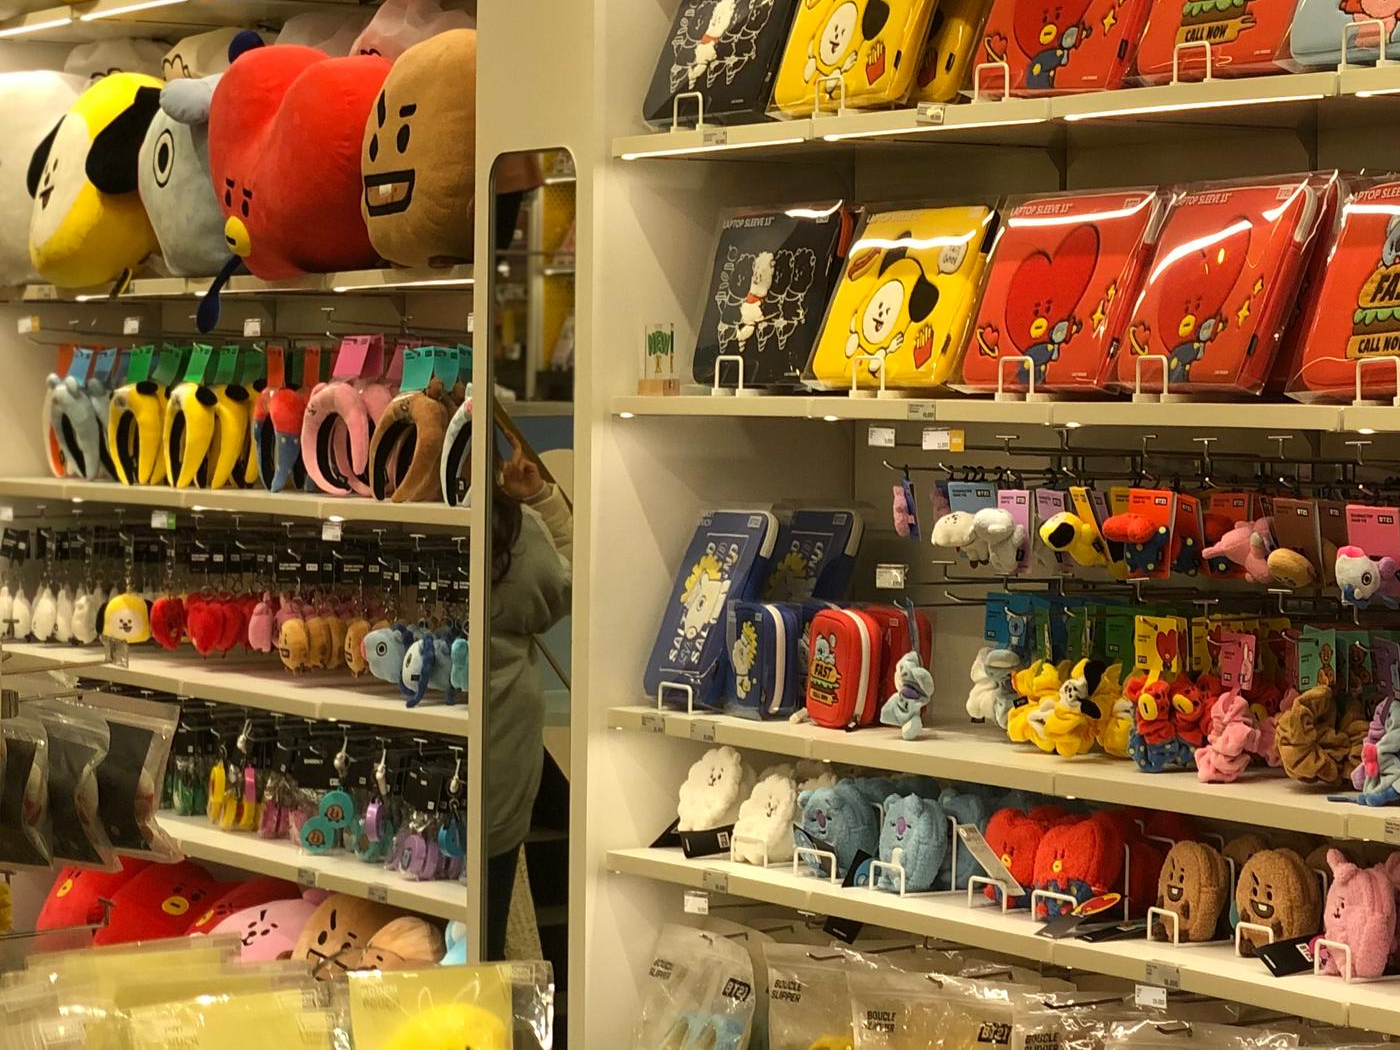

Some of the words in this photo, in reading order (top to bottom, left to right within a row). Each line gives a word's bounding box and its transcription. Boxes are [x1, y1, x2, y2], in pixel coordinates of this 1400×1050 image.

[1185, 27, 1206, 43] CALL
[1206, 24, 1229, 39] NOW
[1037, 204, 1060, 215] SLEEVE
[648, 330, 671, 357] NEW
[1358, 338, 1380, 352] CALL
[815, 663, 833, 679] FAST
[774, 978, 801, 992] BOUCLE
[771, 990, 801, 1003] SLIPPER
[867, 1010, 896, 1022] BOUCLE
